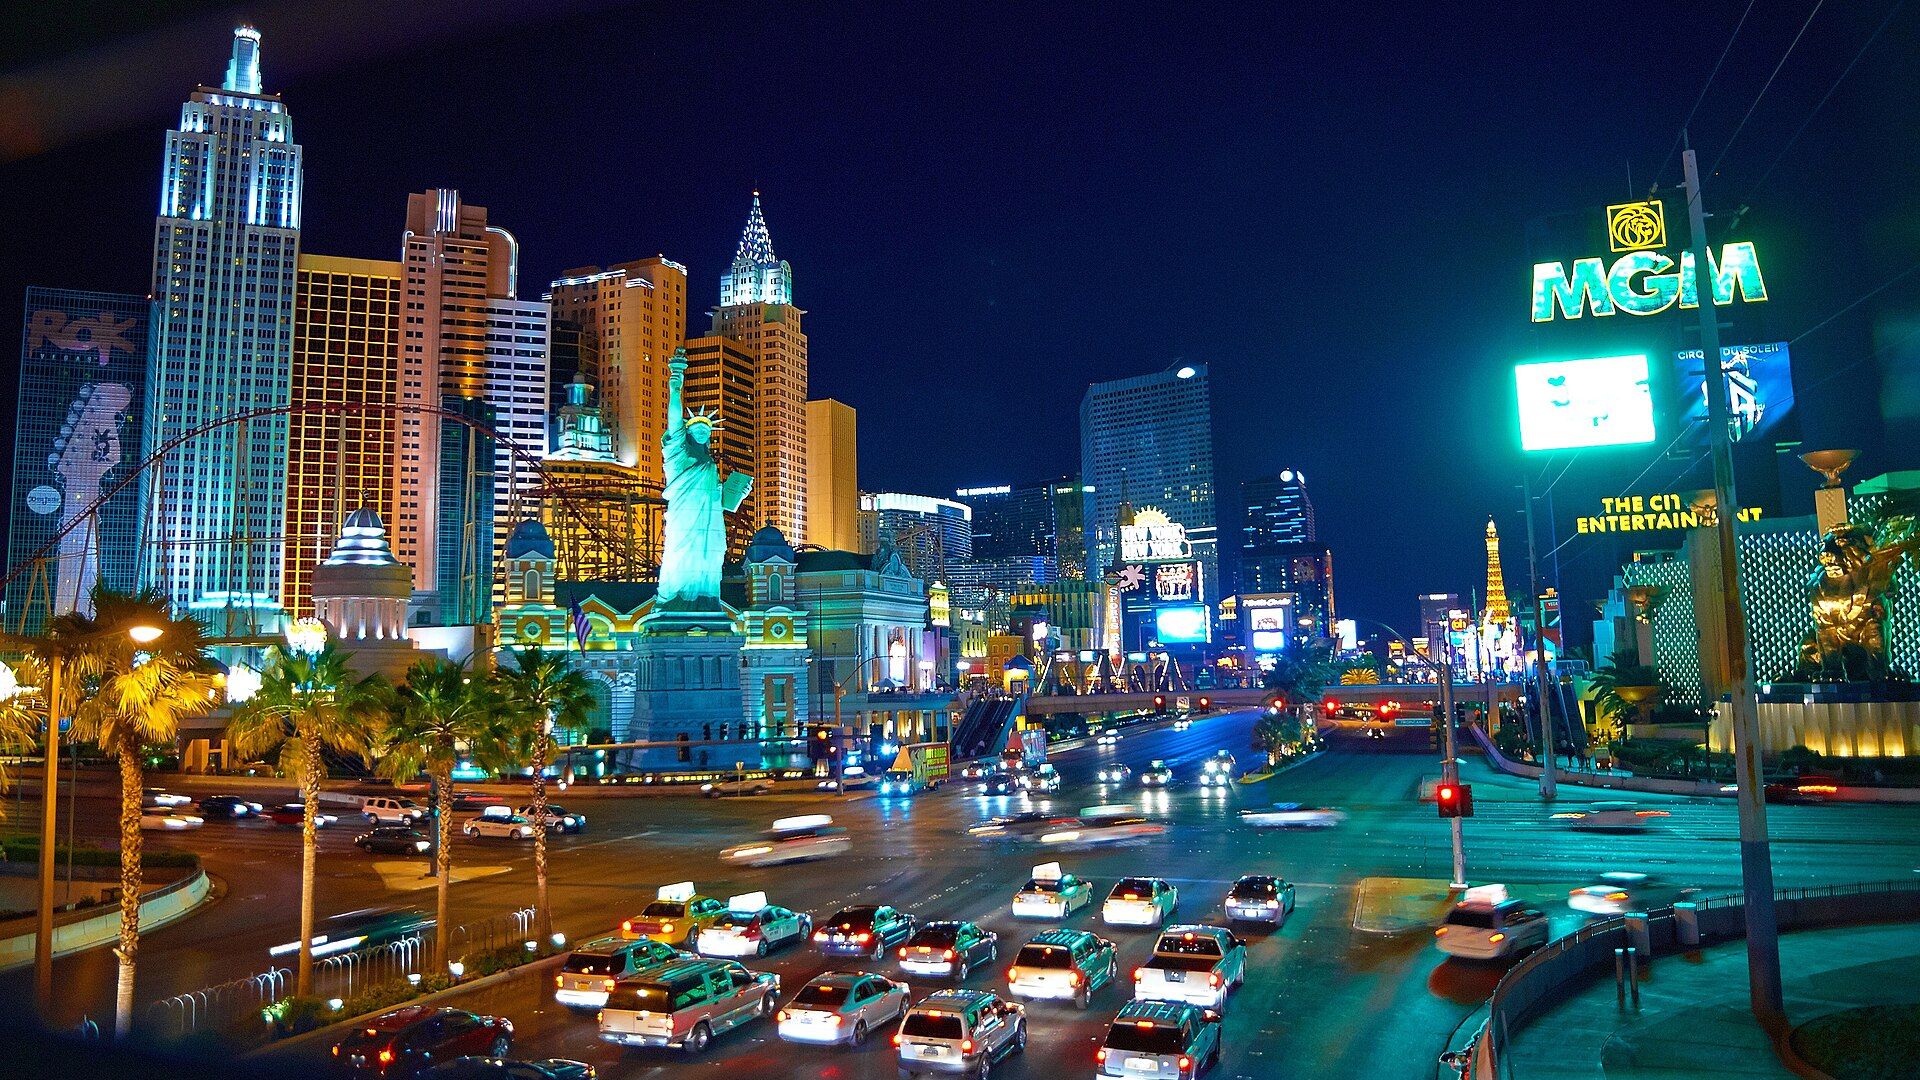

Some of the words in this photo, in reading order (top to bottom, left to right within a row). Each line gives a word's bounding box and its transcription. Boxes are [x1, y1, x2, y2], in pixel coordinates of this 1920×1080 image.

[1531, 241, 1768, 323] MGM
[1677, 350, 1705, 360] CIRQ
[1723, 347, 1738, 356] DU
[1601, 496, 1644, 514] THE
[1649, 494, 1681, 511] CIT
[1576, 507, 1763, 534] ENTERTAINNT
